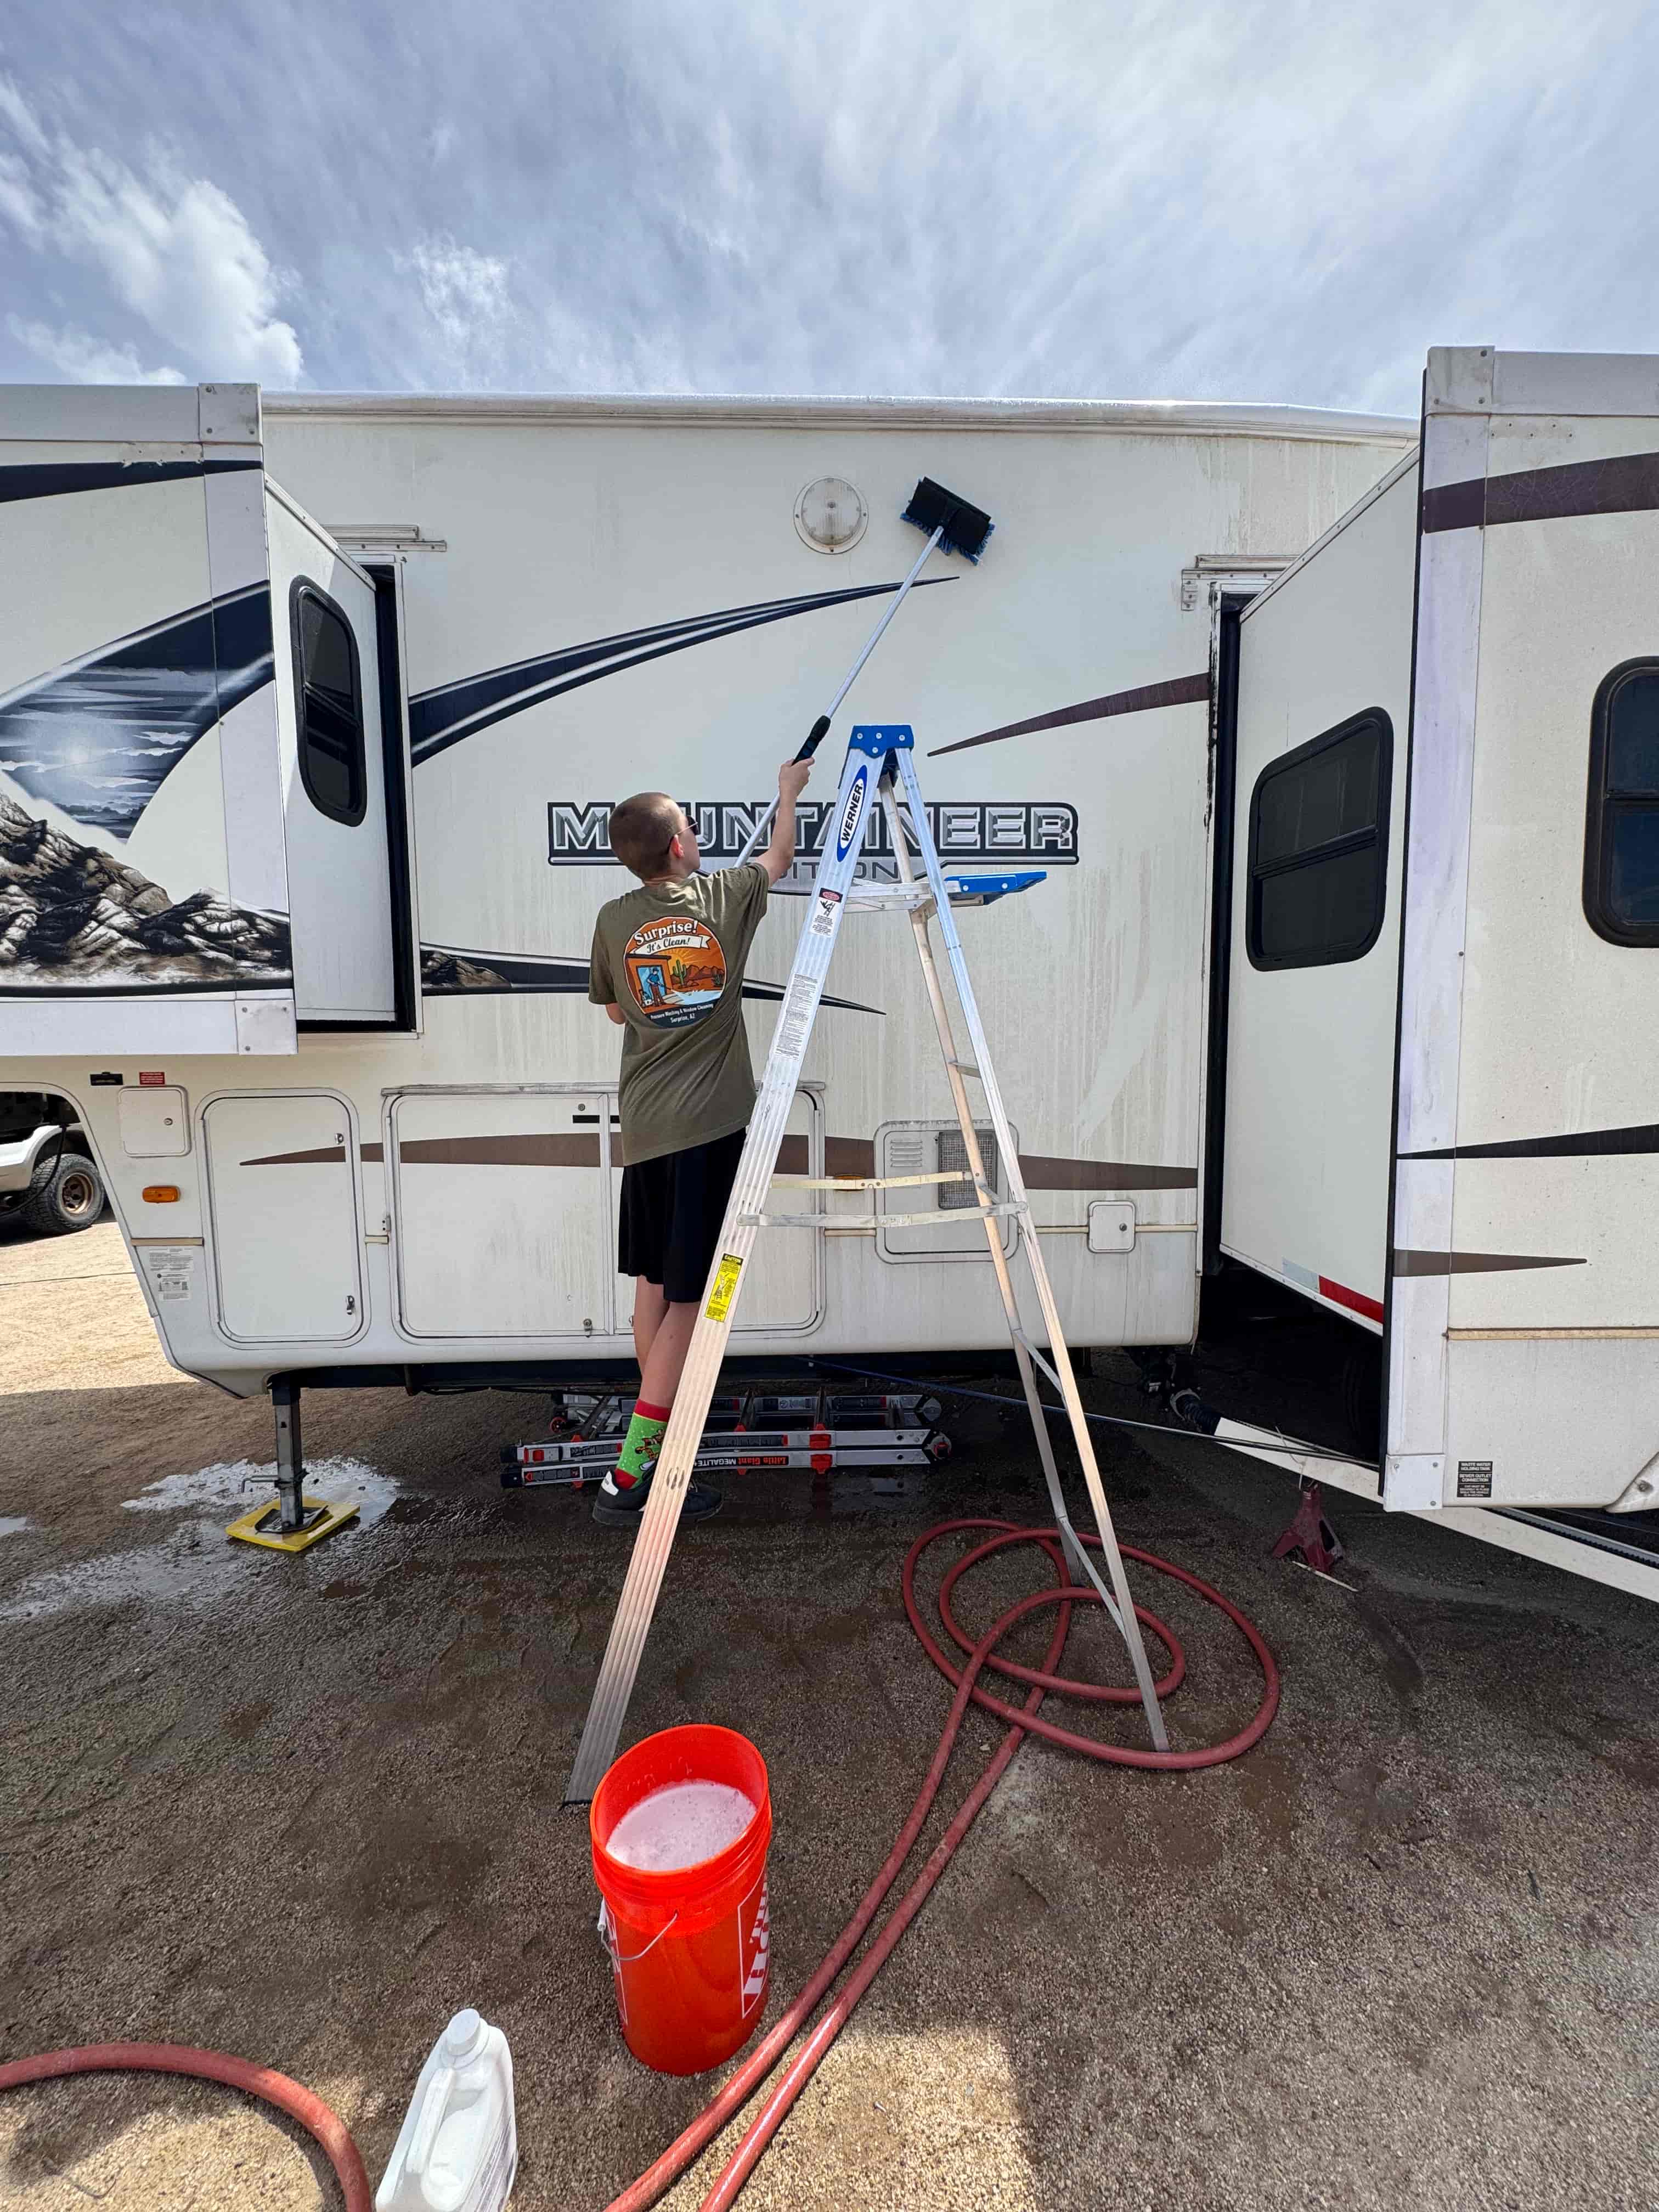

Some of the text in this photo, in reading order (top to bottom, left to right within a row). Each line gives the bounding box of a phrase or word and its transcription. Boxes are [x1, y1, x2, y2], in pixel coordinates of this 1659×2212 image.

[842, 784, 863, 842] WERNER
[634, 921, 698, 945] Surprise!
[647, 937, 690, 953] It's Clean!
[738, 1457, 761, 1465] Giant
[763, 1457, 786, 1465] Little
